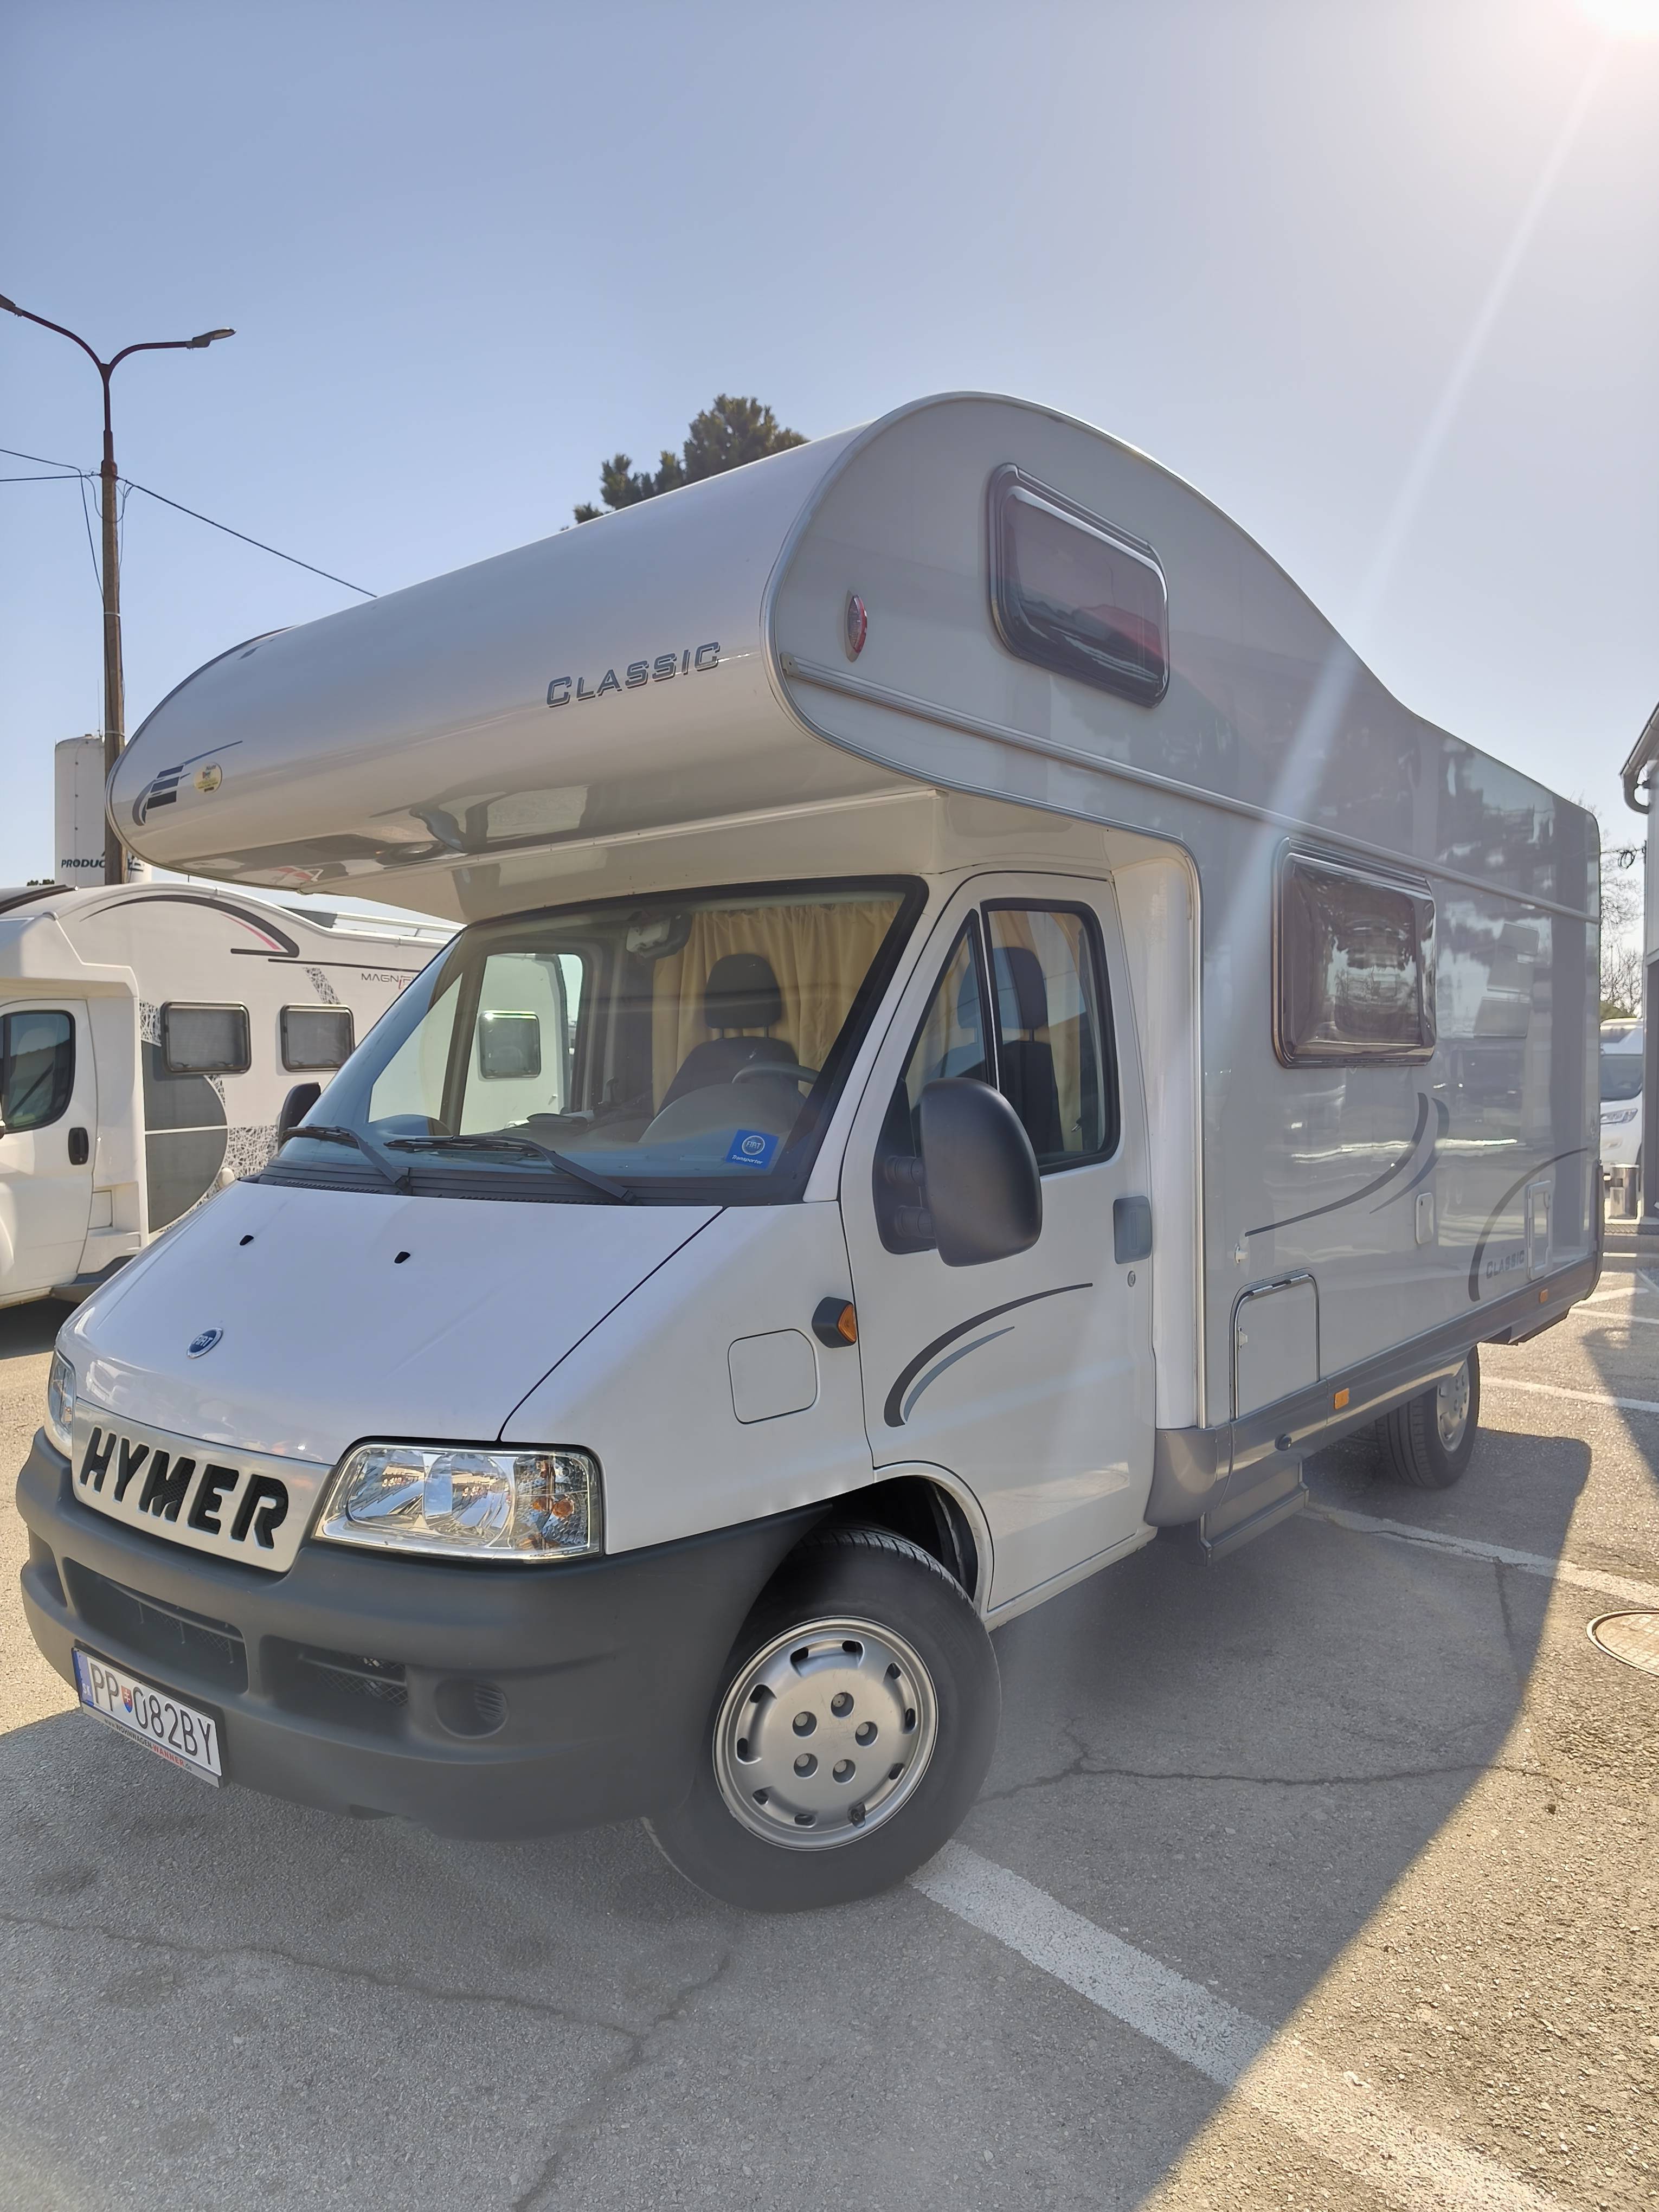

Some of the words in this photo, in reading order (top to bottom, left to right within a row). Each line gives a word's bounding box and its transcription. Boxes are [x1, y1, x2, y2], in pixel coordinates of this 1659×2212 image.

[546, 642, 721, 708] CLASSIC
[745, 1140, 762, 1149] FIAT
[731, 1154, 763, 1165] Transporter
[1486, 1250, 1525, 1279] CLASSIC
[79, 1426, 288, 1549] HYMER
[82, 1682, 91, 1696] SK
[90, 1662, 120, 1712] PP
[133, 1686, 211, 1766] 082BY
